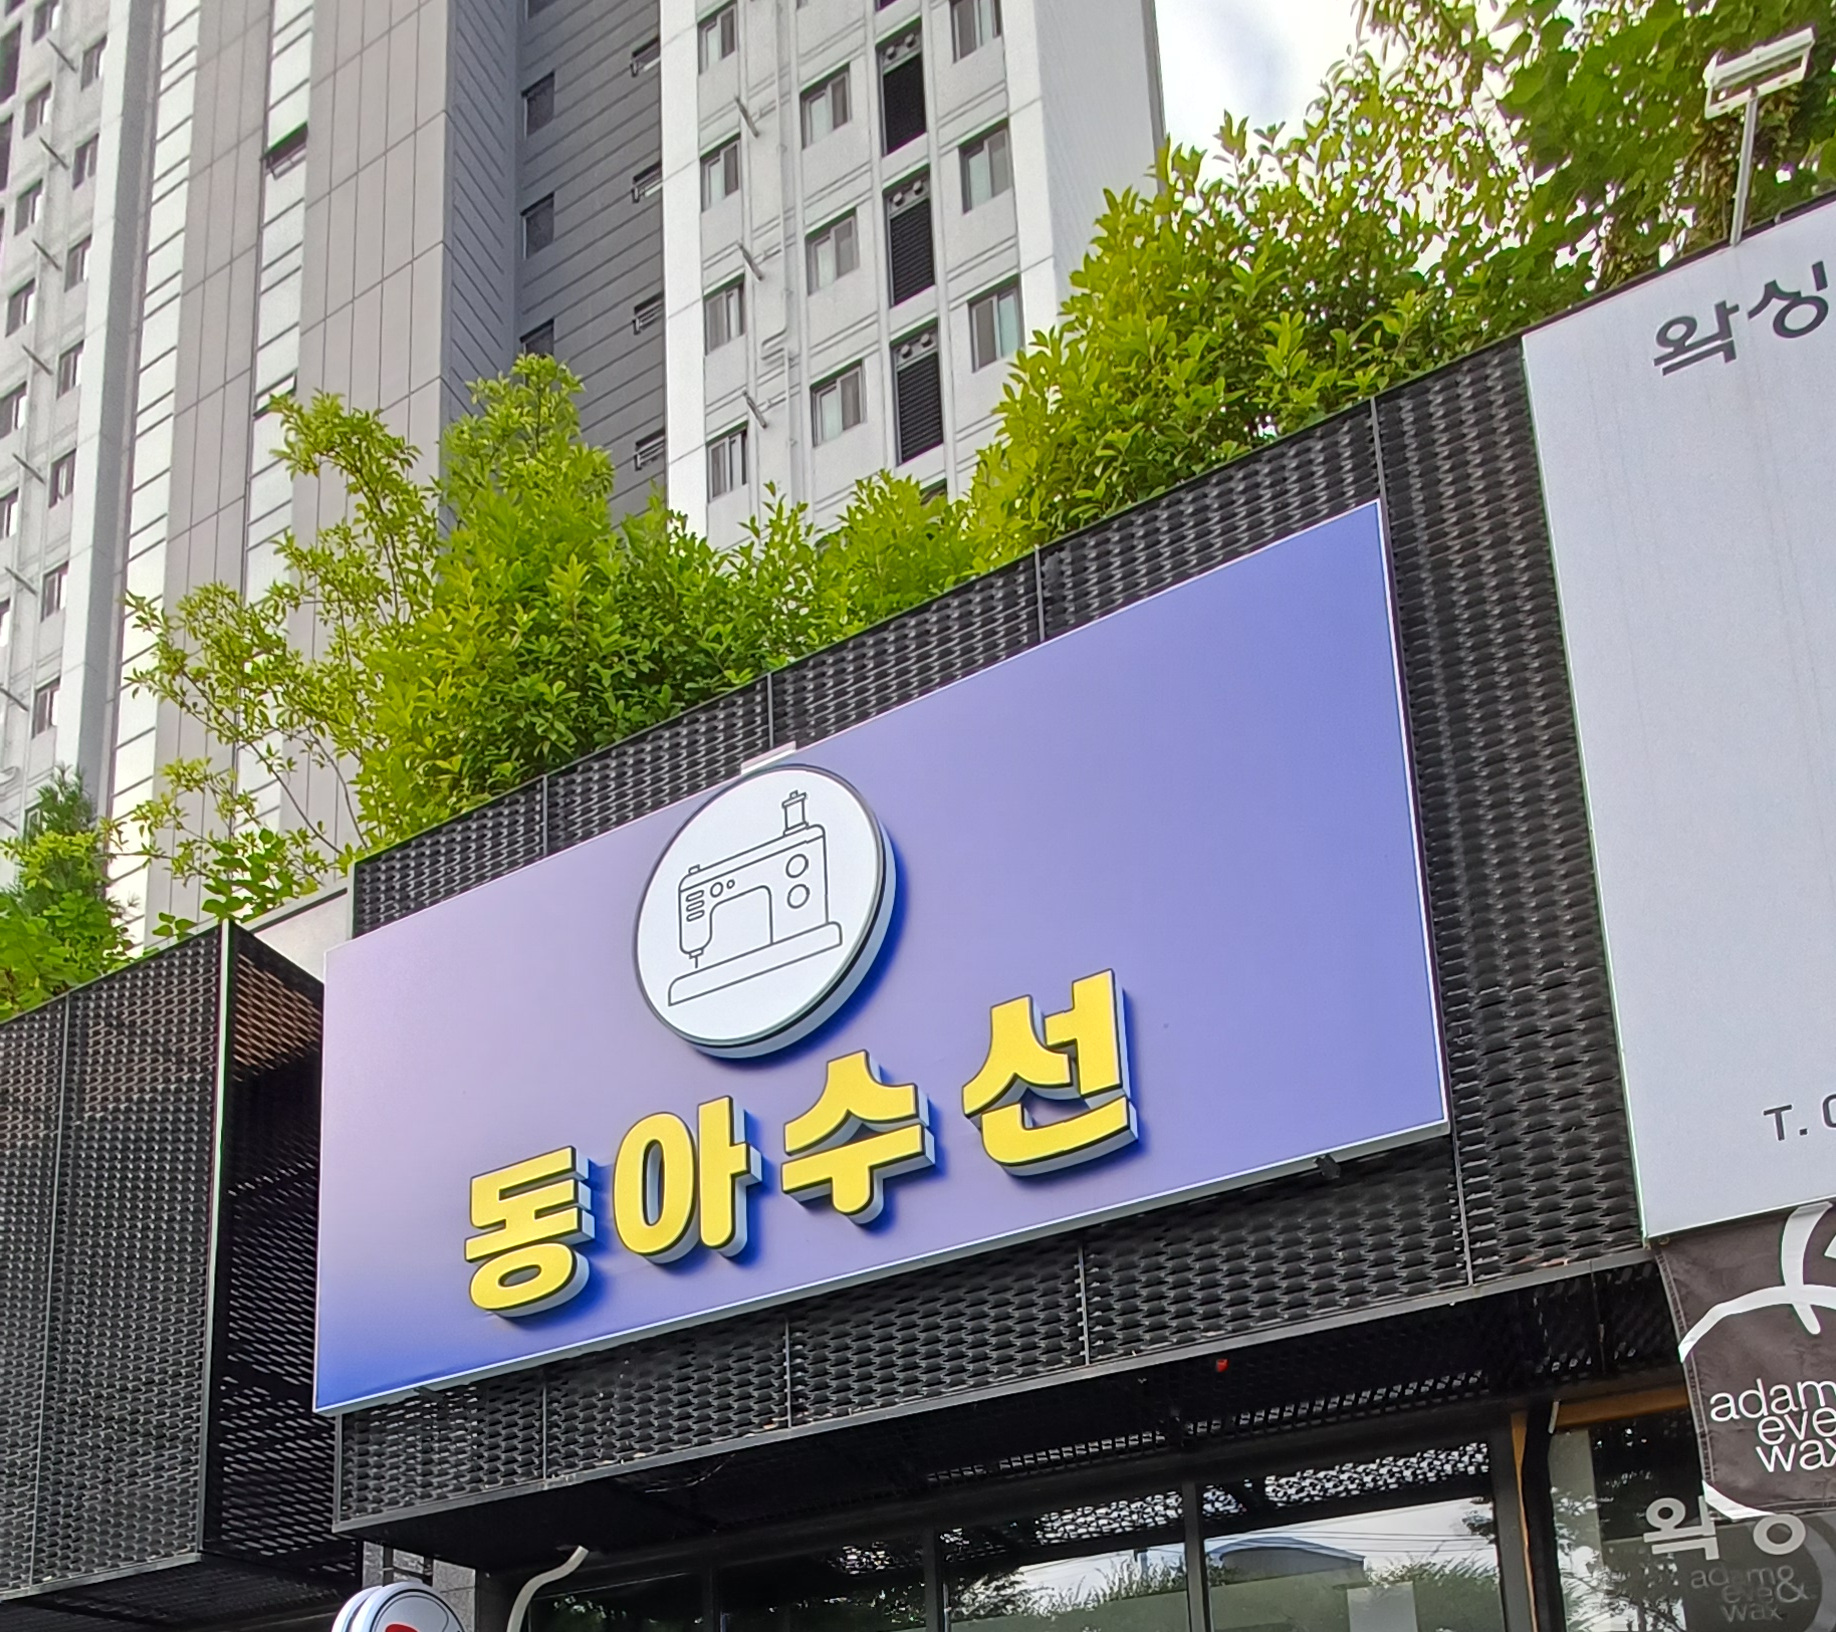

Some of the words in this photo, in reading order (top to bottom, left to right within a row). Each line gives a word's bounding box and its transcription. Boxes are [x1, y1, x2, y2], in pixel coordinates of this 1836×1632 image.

[1653, 260, 1829, 376] 왁싱
[464, 968, 1138, 1318] 동아수선
[1757, 1406, 1836, 1446] eve
